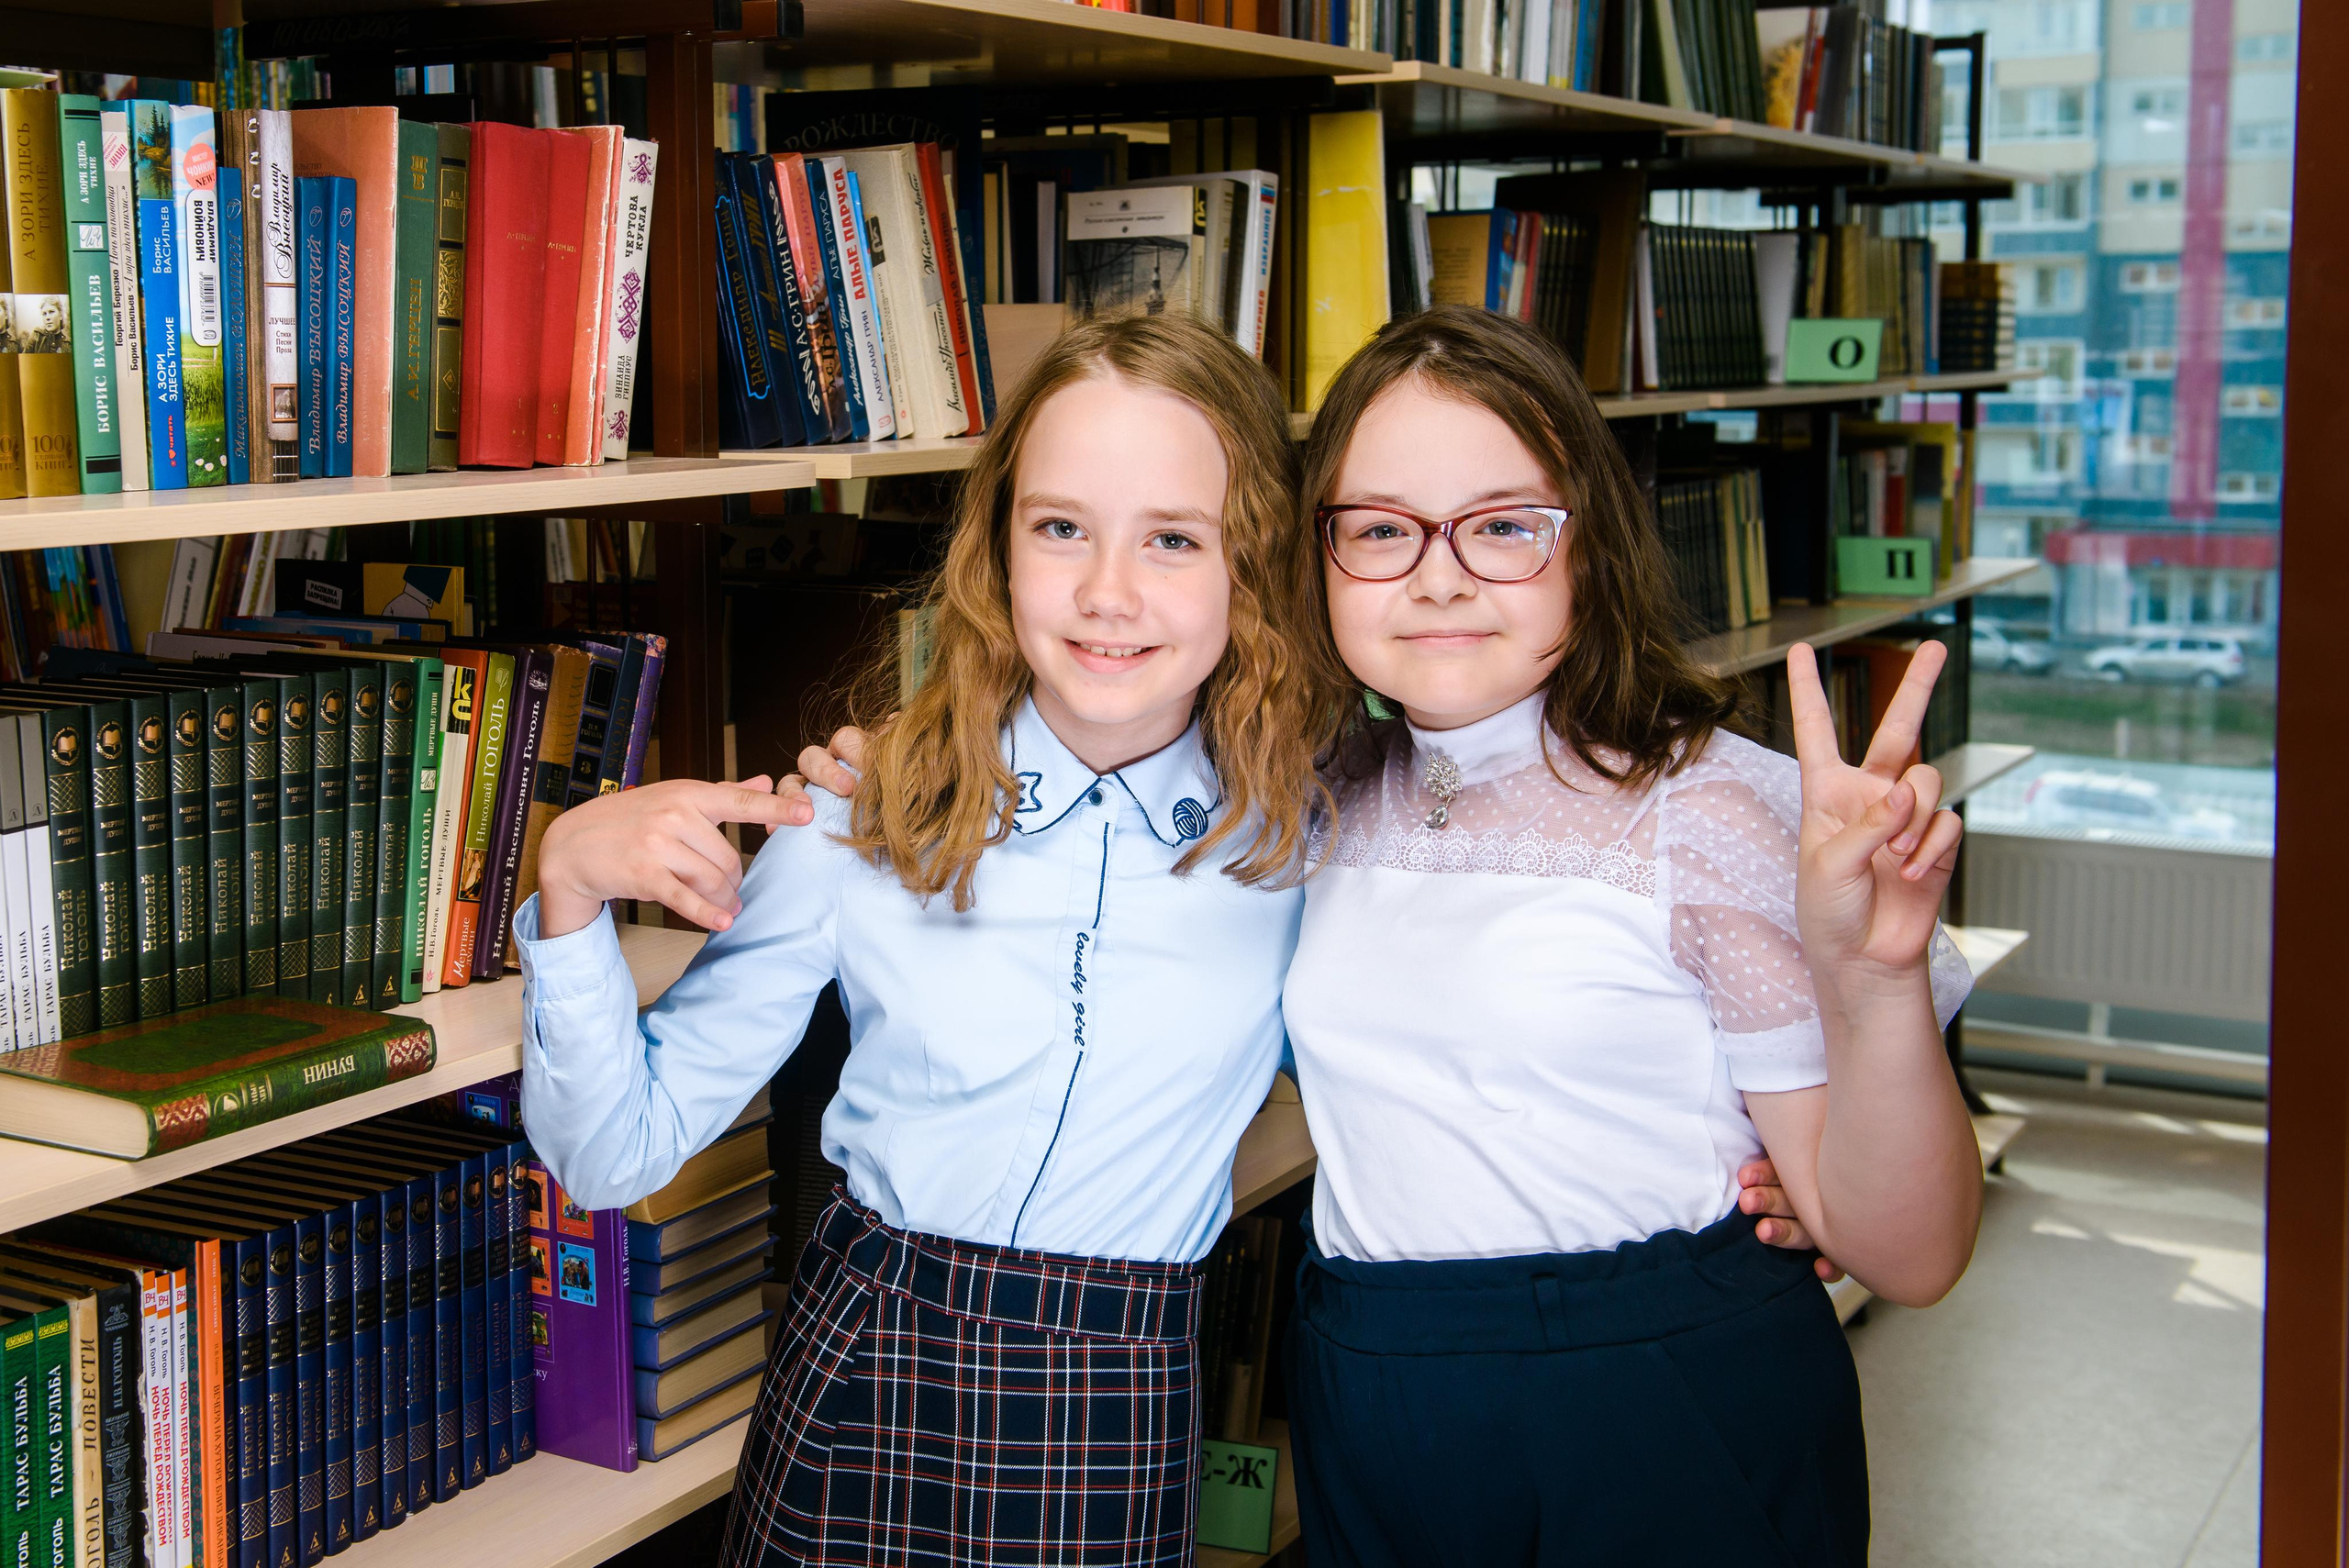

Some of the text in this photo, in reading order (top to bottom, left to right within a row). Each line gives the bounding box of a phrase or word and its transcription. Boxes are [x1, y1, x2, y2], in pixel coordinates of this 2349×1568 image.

[77, 140, 88, 169] ЗДЕСЬ
[78, 170, 89, 194] ЗОРИ
[89, 157, 98, 188] ТИХИЕ
[17, 122, 36, 261] А ЗОРИ ЗДЕСЬ
[266, 162, 282, 248] Владимир
[152, 238, 161, 273] Борис
[161, 206, 173, 273] ВАСИЛЬЕВ
[194, 200, 206, 261] ВОЙНОВИЧ
[207, 201, 217, 263] ВЛАДИМИР
[274, 174, 294, 278] Высоцкий
[625, 195, 639, 258] ЧЕРТОВА
[636, 206, 647, 250] КУКЛА
[106, 185, 124, 347] Георгий Березко Ночь полководца
[819, 191, 863, 406] Александр Грин АЛЫЕ ПАРУСА
[833, 167, 885, 402] АЛЕКСАНДР ГРИН АЛЫЕ ПАРУСА
[128, 295, 137, 339] Васильев
[229, 230, 247, 458] Максимилиан ВОЛОШИН
[269, 317, 296, 326] ЛУЧШЕЕ
[307, 235, 323, 454] Владимир ВЫСОЦКИЙ
[336, 240, 352, 444] Владимир ВЫСОЦКИЙ
[89, 274, 110, 433] БОРИС ВАСИЛЬЕВ
[130, 341, 140, 372] Борис
[157, 354, 168, 402] А ЗОРИ
[165, 317, 178, 402] ЗДЕСЬ ТИХИЕ
[615, 355, 625, 398] ЗИНАИДА
[623, 355, 632, 400] ГИППИУС
[30, 434, 65, 453] 100
[1887, 550, 1915, 580] П
[428, 692, 439, 757] МЕРТВЫЕ ДУШИ
[476, 697, 505, 842] Николай ГОГОЛЬ
[580, 761, 592, 774] 3
[381, 822, 395, 895] Николай
[436, 844, 447, 895] МЕРТВЫЕ
[443, 809, 451, 841] ДУШИ
[492, 700, 540, 960] Николай Васильевич Гоголь
[214, 858, 227, 935] Николай
[250, 850, 263, 926] Николай
[284, 843, 296, 917] Николай
[317, 837, 330, 910] Николай
[350, 829, 363, 902] Николай
[416, 807, 433, 957] НИКОЛАЙ ГОГОЛЬ
[57, 889, 74, 972] Николай
[99, 881, 117, 962] Николай
[140, 873, 157, 953] Николай
[177, 865, 192, 943] Николай
[18, 930, 29, 979] БУЛЬБА
[41, 925, 52, 973] БУЛЬБА
[453, 917, 471, 979] Мертвые
[21, 984, 32, 1024] ТАРАС
[44, 977, 55, 1018] ТАРАС
[1070, 931, 1090, 1048] lovely girl
[303, 1055, 356, 1084] БУНИН
[622, 1225, 630, 1262] Гоголь
[80, 1338, 97, 1451] ПОВЕСТИ
[151, 1385, 160, 1420] НОЧЬ
[161, 1386, 170, 1421] НОЧЬ
[180, 1381, 188, 1416] НОЧЬ
[15, 1376, 29, 1511] ТАРАС БУЛЬБА
[48, 1364, 64, 1498] ТАРАС БУЛЬБА
[153, 1422, 163, 1463] ПЕРЕД
[180, 1416, 189, 1457] ПЕРЕД
[215, 1423, 221, 1441] НА
[215, 1443, 223, 1485] ХУТОРЕ
[155, 1463, 167, 1547] РОЖДЕСТВОМ
[181, 1459, 190, 1540] РОЖДЕСТВОМ
